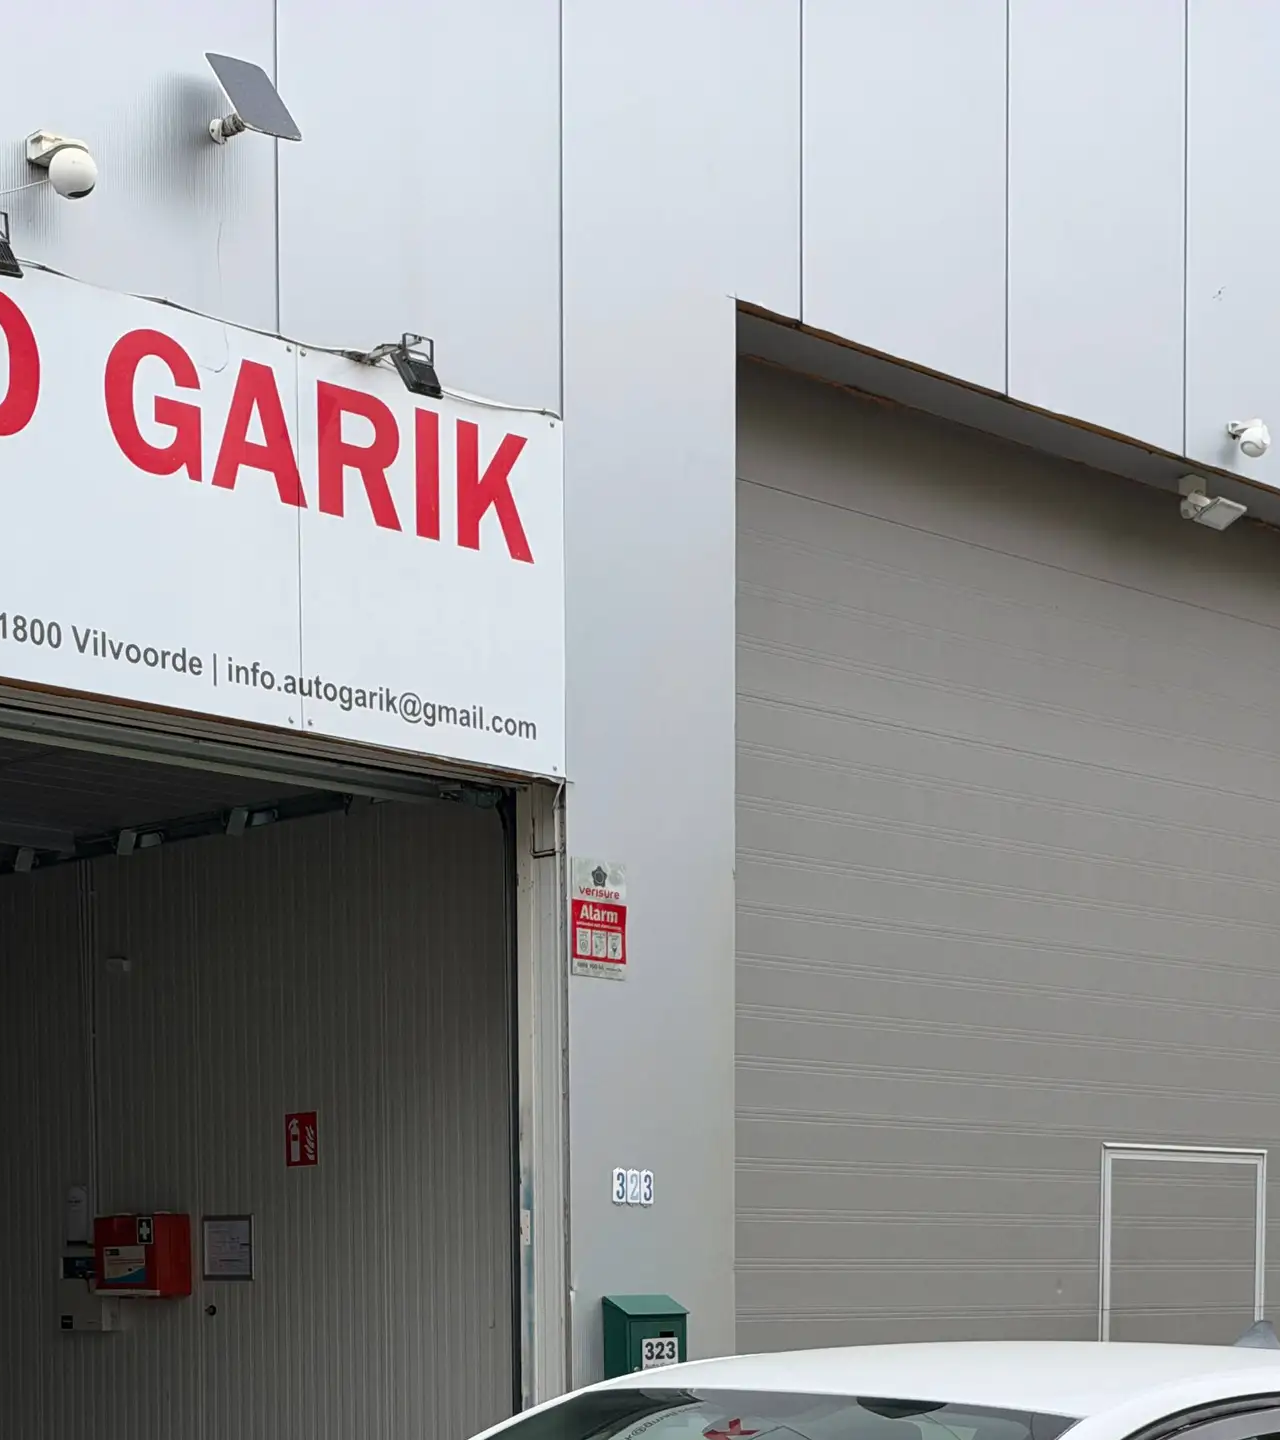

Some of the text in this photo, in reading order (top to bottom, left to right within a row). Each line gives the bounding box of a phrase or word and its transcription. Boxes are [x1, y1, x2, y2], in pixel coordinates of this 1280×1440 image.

[105, 328, 534, 564] GARIK
[71, 625, 203, 676] Vilvoorde
[228, 656, 537, 740] info.autogarik@gmail.com
[579, 886, 620, 900] verisure
[580, 904, 618, 923] Alarm
[616, 1171, 653, 1201] 323
[644, 1340, 676, 1361] 323
